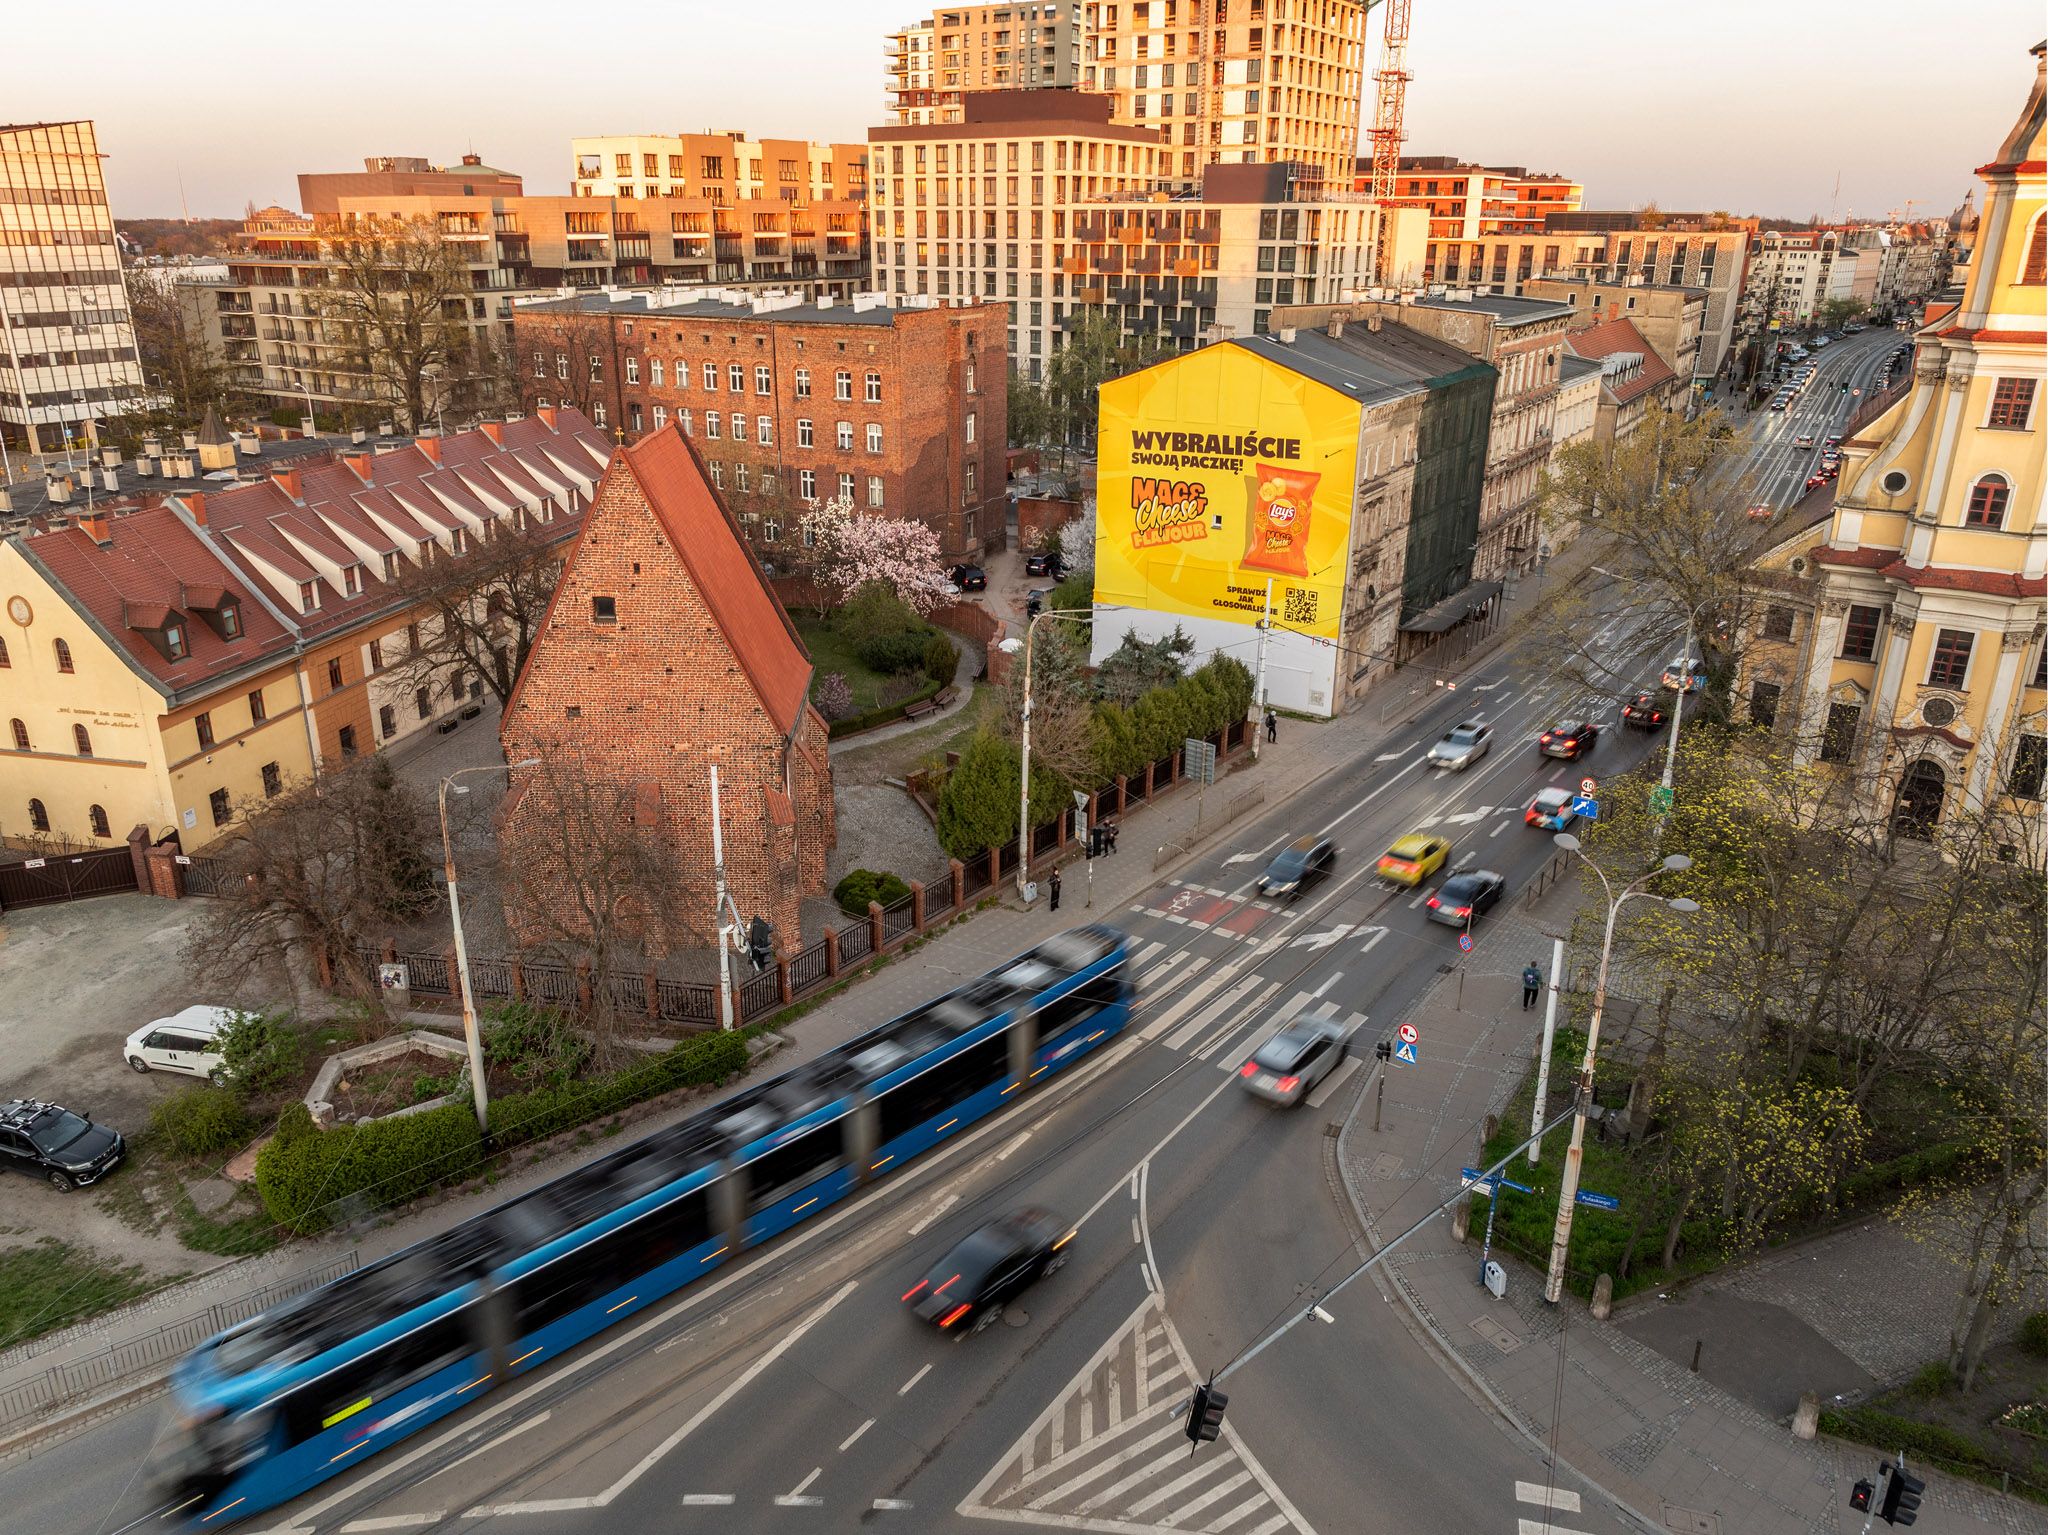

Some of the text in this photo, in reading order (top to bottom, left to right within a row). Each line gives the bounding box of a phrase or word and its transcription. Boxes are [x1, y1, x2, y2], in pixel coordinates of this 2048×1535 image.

[1132, 430, 1301, 460] WYBRALIŚCIE
[1131, 452, 1244, 475] SWOJĄ PACZKĘ!
[1136, 495, 1198, 537] Cheese
[1132, 522, 1206, 548] FLAVOUR
[1227, 586, 1267, 597] SPRAWDŹ
[1238, 595, 1254, 603] JAK
[1213, 599, 1278, 615] GŁOSOWALIŚIE
[1583, 781, 1594, 790] 40
[1582, 1195, 1611, 1206] Pułaskiego
